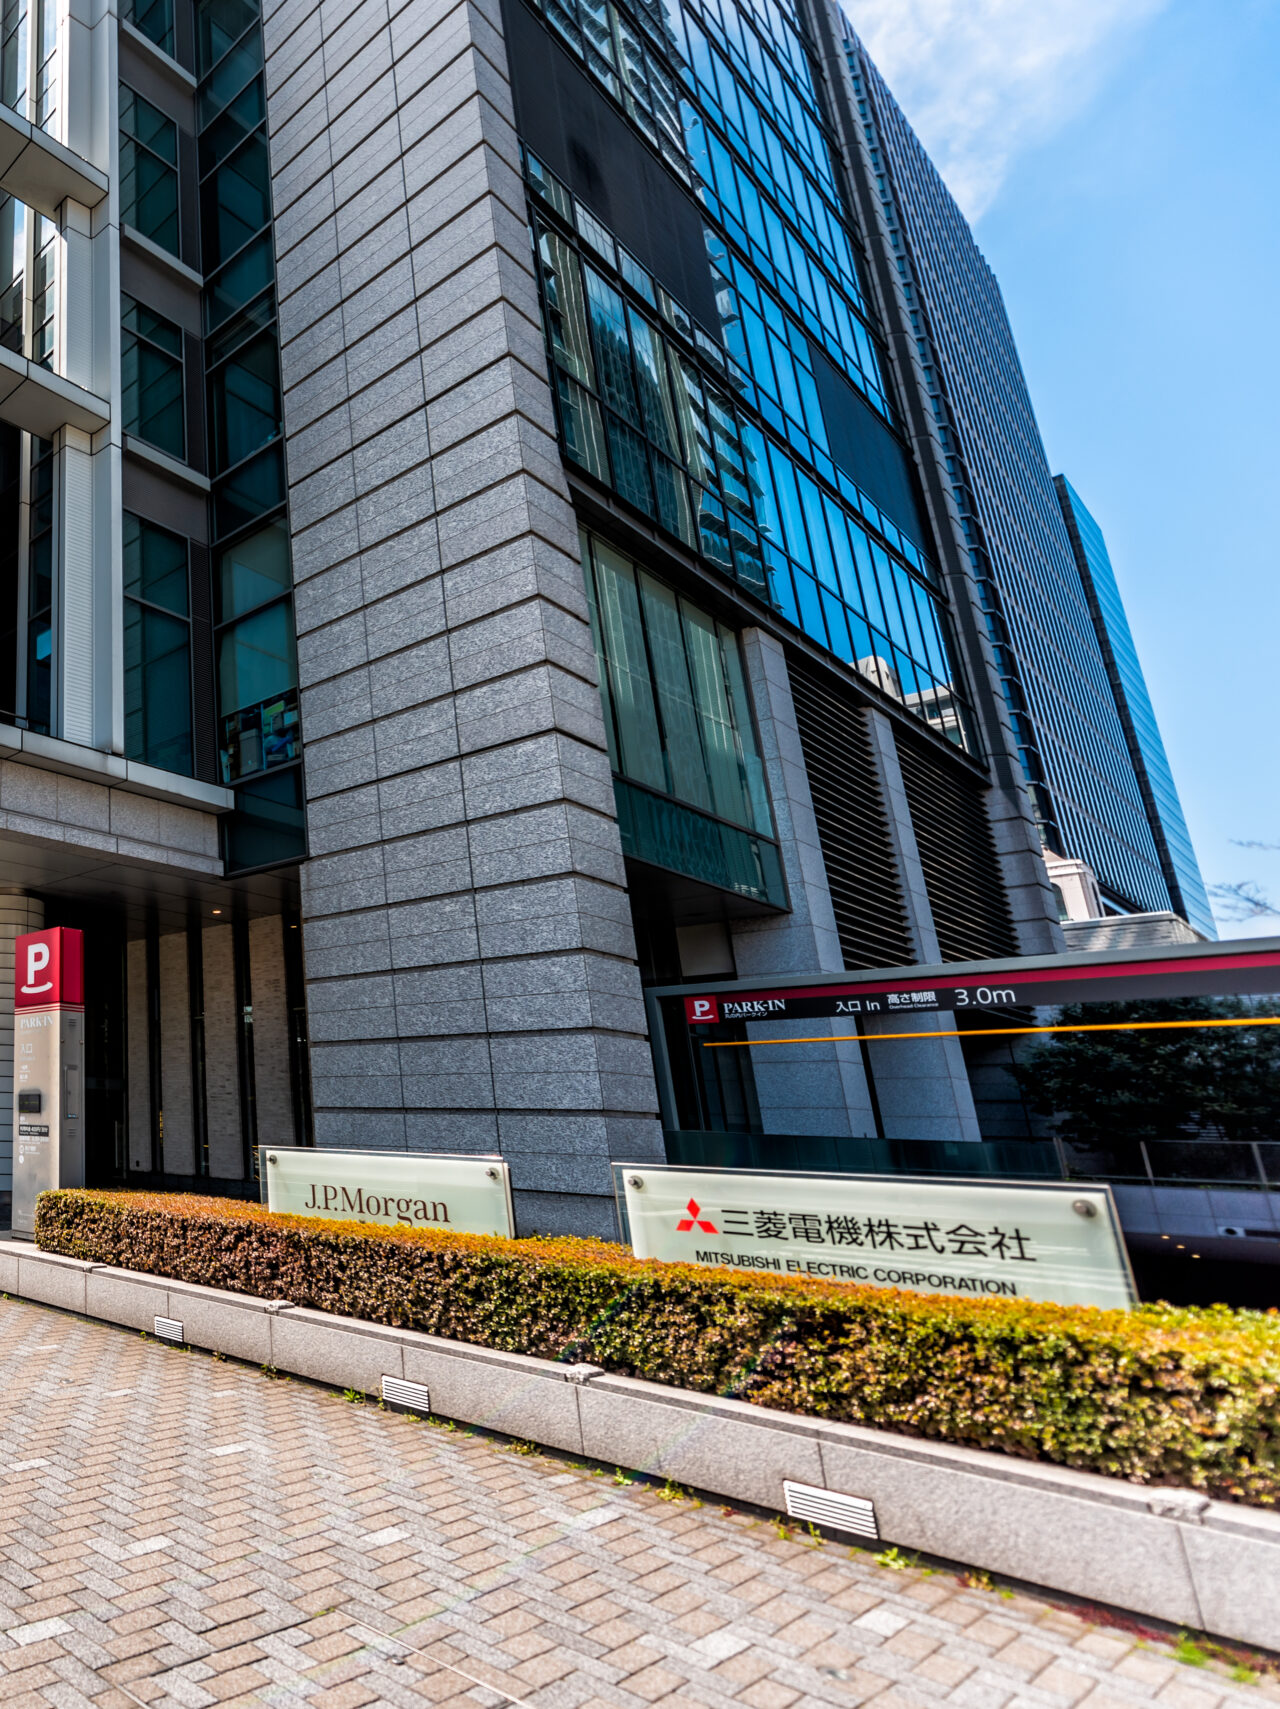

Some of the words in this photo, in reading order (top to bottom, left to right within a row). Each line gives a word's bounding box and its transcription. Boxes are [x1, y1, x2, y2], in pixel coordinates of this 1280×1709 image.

[27, 942, 50, 985] P
[886, 991, 937, 1004] 高さ制限
[954, 987, 1016, 1006] 3.0m
[694, 1000, 710, 1017] P
[723, 999, 786, 1014] PARK-IN
[724, 1011, 768, 1019] 丸の内パークイン
[836, 1000, 862, 1013] 入口
[866, 1000, 880, 1011] In
[305, 1184, 451, 1227] J.P.Morgan
[721, 1209, 1037, 1262] 三菱電機株式会社
[695, 1250, 781, 1270] MITSUBISHI
[786, 1259, 869, 1280] ELECTRIC
[874, 1268, 1017, 1296] CORPORATION
